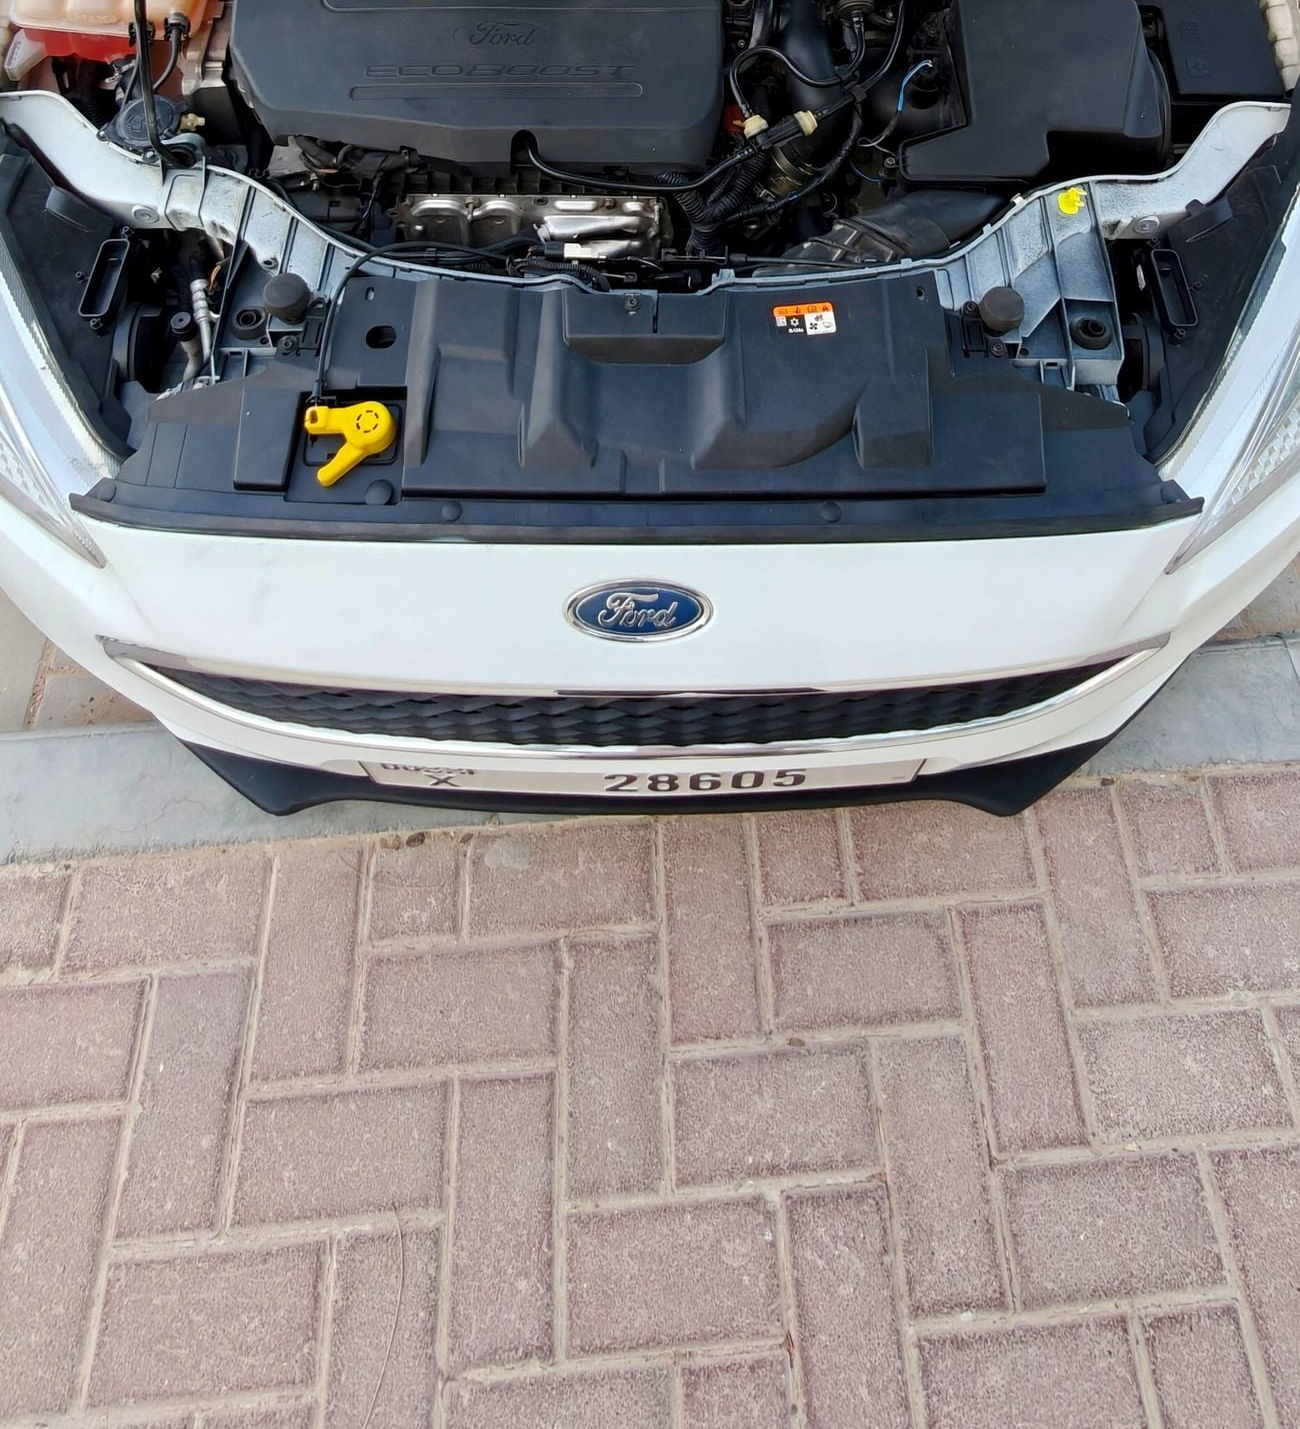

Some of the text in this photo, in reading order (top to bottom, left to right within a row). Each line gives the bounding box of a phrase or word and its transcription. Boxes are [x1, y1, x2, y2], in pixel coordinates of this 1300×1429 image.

[469, 22, 534, 46] Ford
[364, 65, 637, 78] ECOBOOST
[598, 592, 679, 628] Ford
[424, 769, 806, 792] X 28605
